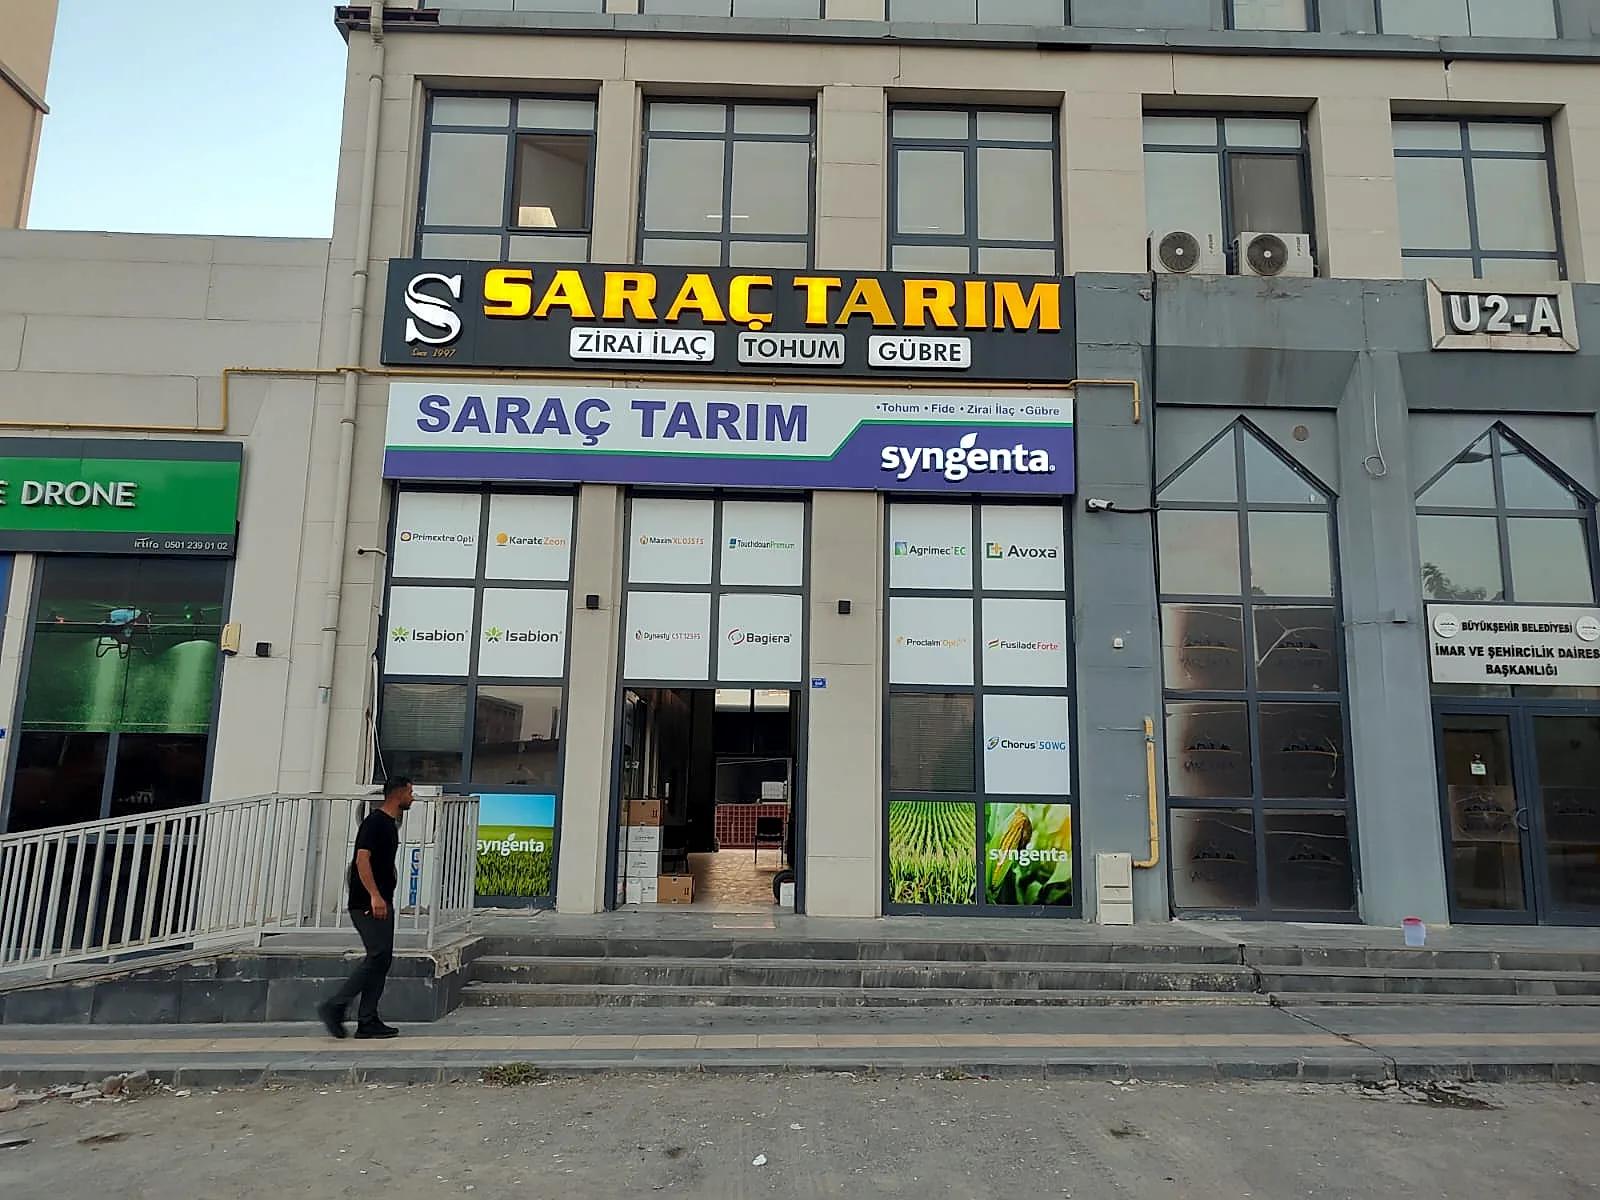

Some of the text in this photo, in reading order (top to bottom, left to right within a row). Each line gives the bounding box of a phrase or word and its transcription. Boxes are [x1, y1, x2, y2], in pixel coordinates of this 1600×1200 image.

[482, 268, 1061, 331] SARAÇ TARIM
[1450, 294, 1561, 333] U2-A
[578, 330, 707, 360] ZİRAİ İLAÇ
[743, 338, 840, 359] TOHUM
[878, 338, 962, 362] GÜBRE
[416, 394, 808, 446] SARAÇ TARIM
[20, 480, 138, 507] DRONE
[164, 541, 185, 549] 0501
[186, 541, 203, 549] 239
[204, 541, 214, 550] 01
[216, 542, 228, 550] 02
[1007, 545, 1057, 558] Avoxa
[412, 629, 465, 642] Isabion
[1461, 620, 1520, 633] BÜYÜKŞEHİR
[1522, 621, 1573, 633] BELEDİYESİ
[505, 630, 559, 642] Isabion
[1435, 643, 1466, 656] İMAR
[1469, 646, 1484, 656] VE
[1488, 644, 1555, 659] ŞEHİRCİLİK
[1486, 663, 1558, 677] BAŞKANLIĞI
[1001, 739, 1036, 750] Chorus
[477, 837, 545, 856] syngenta
[989, 848, 1067, 866] syngenta
